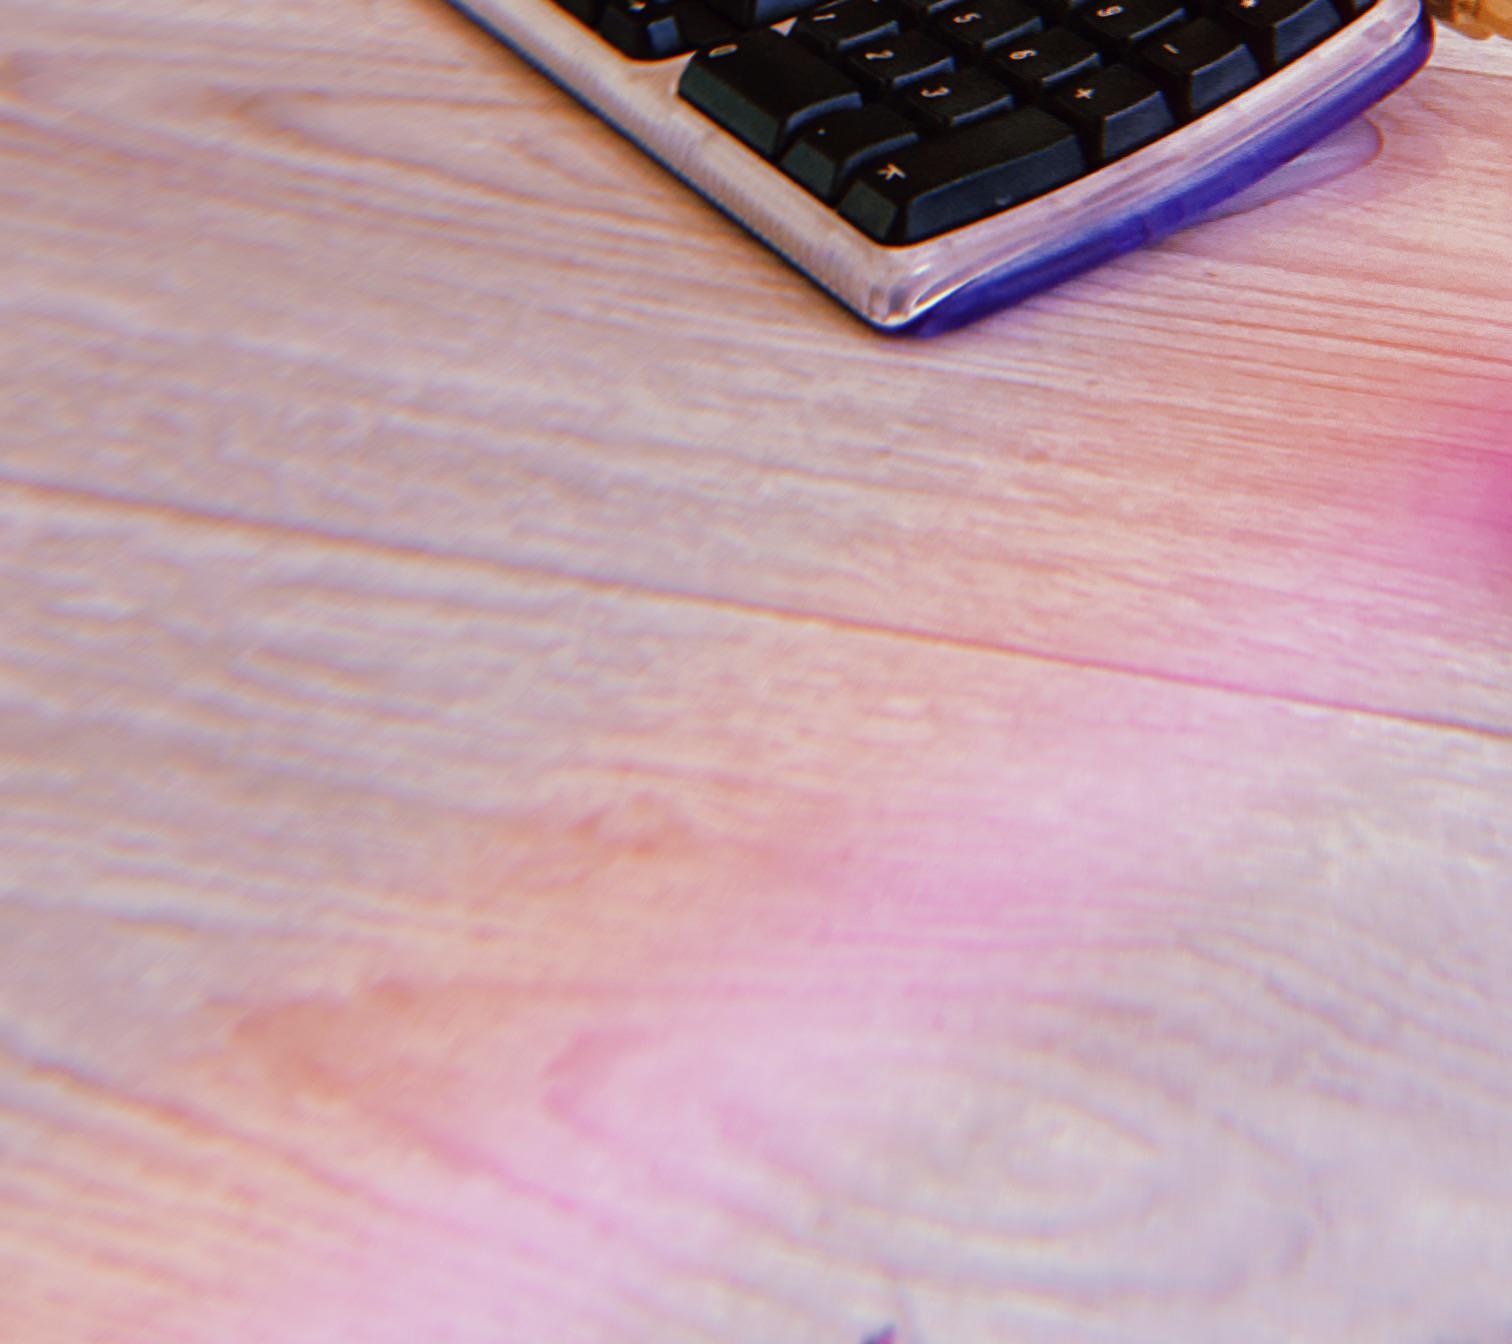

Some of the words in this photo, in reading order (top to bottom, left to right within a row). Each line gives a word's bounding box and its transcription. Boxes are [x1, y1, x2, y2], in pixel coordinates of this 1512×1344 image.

[1095, 5, 1124, 17] 9
[953, 12, 982, 23] 5
[865, 49, 894, 60] 2
[1009, 48, 1038, 60] 6
[920, 86, 950, 98] 3
